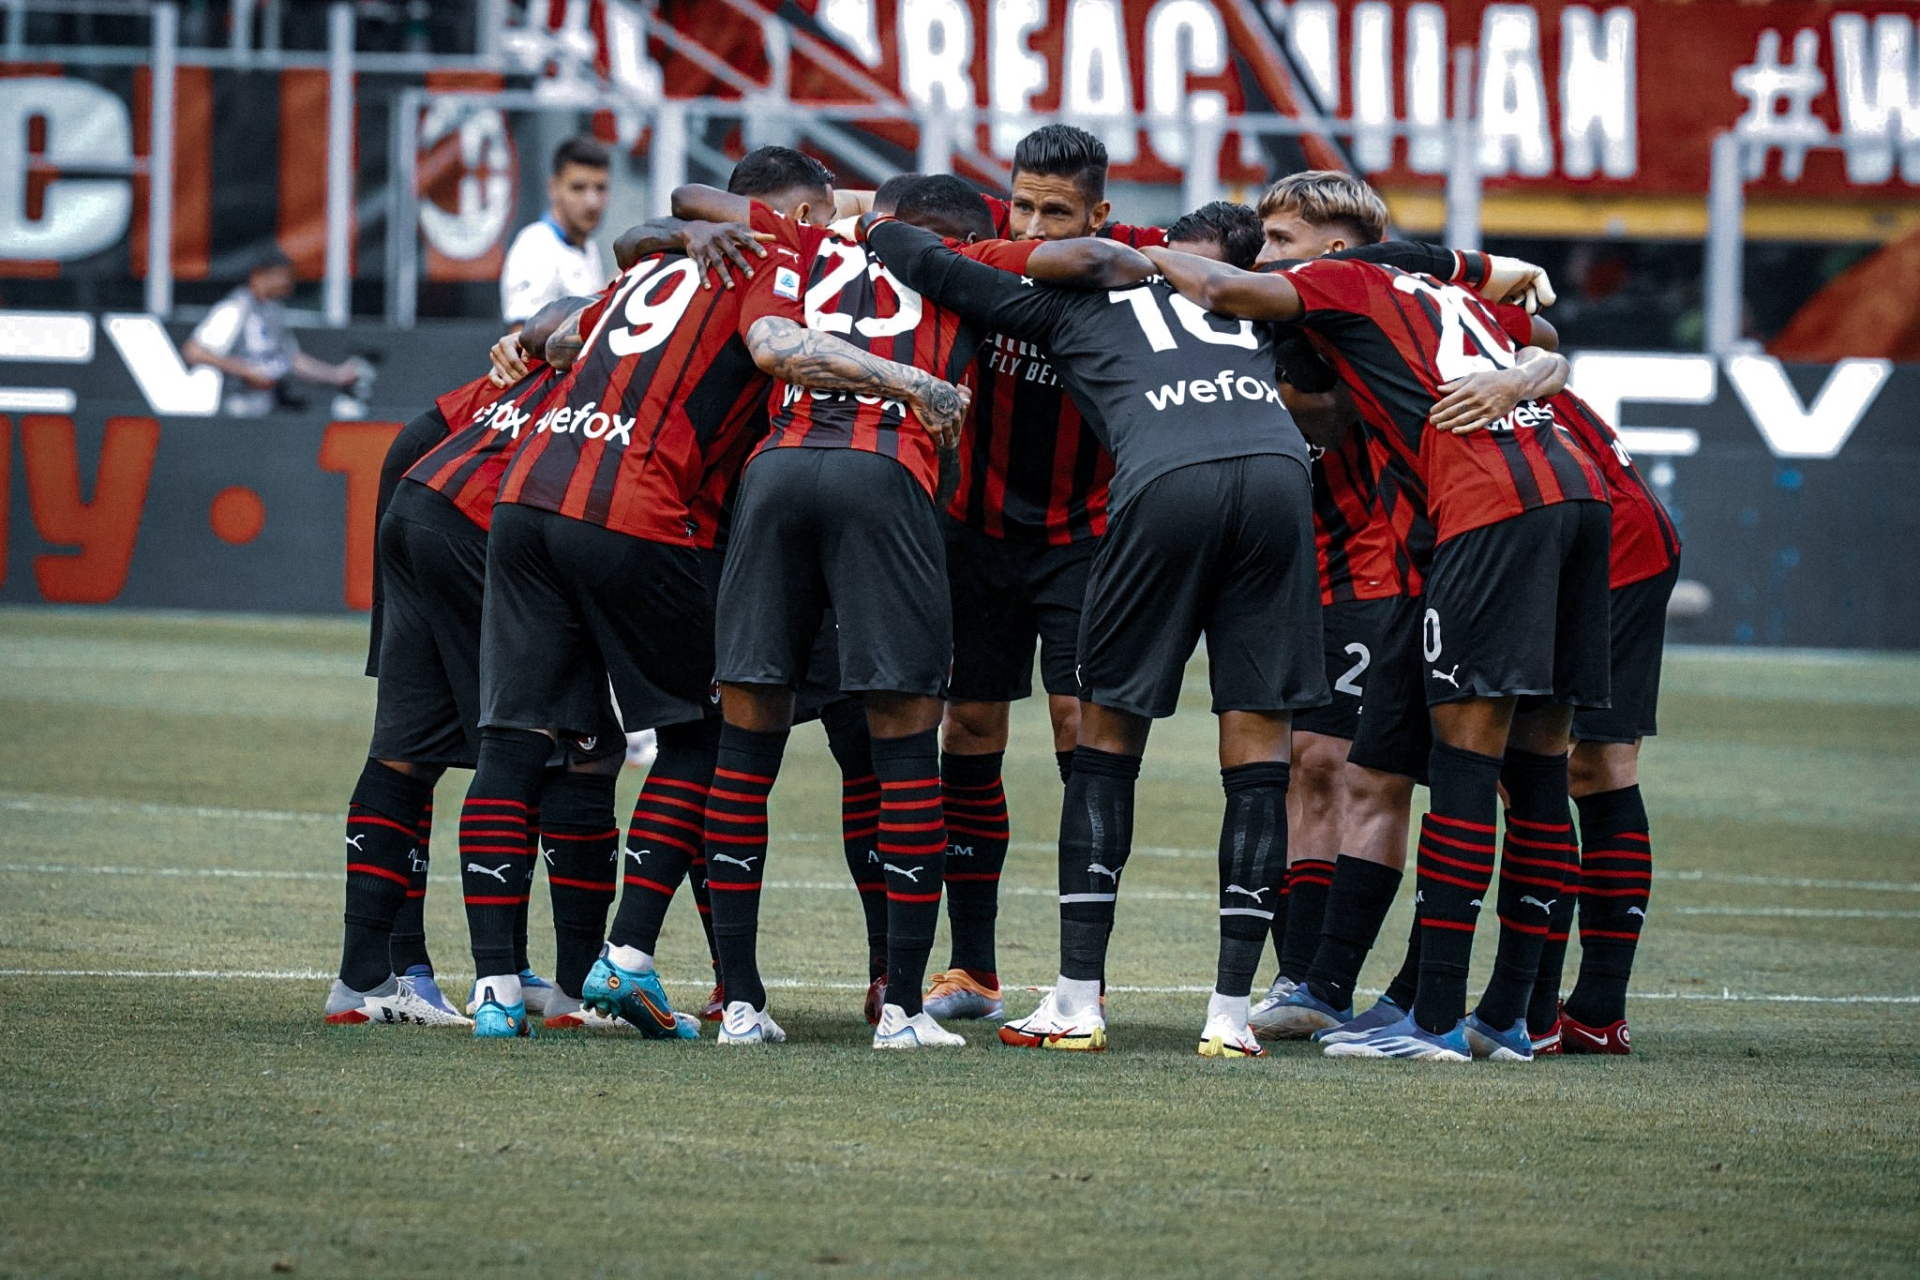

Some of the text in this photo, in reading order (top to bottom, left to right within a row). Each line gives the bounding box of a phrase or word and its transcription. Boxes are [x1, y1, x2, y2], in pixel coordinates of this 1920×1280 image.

[577, 256, 701, 357] 19
[988, 350, 1022, 376] FLY
[1144, 369, 1288, 412] wefox
[1334, 642, 1371, 697] 2
